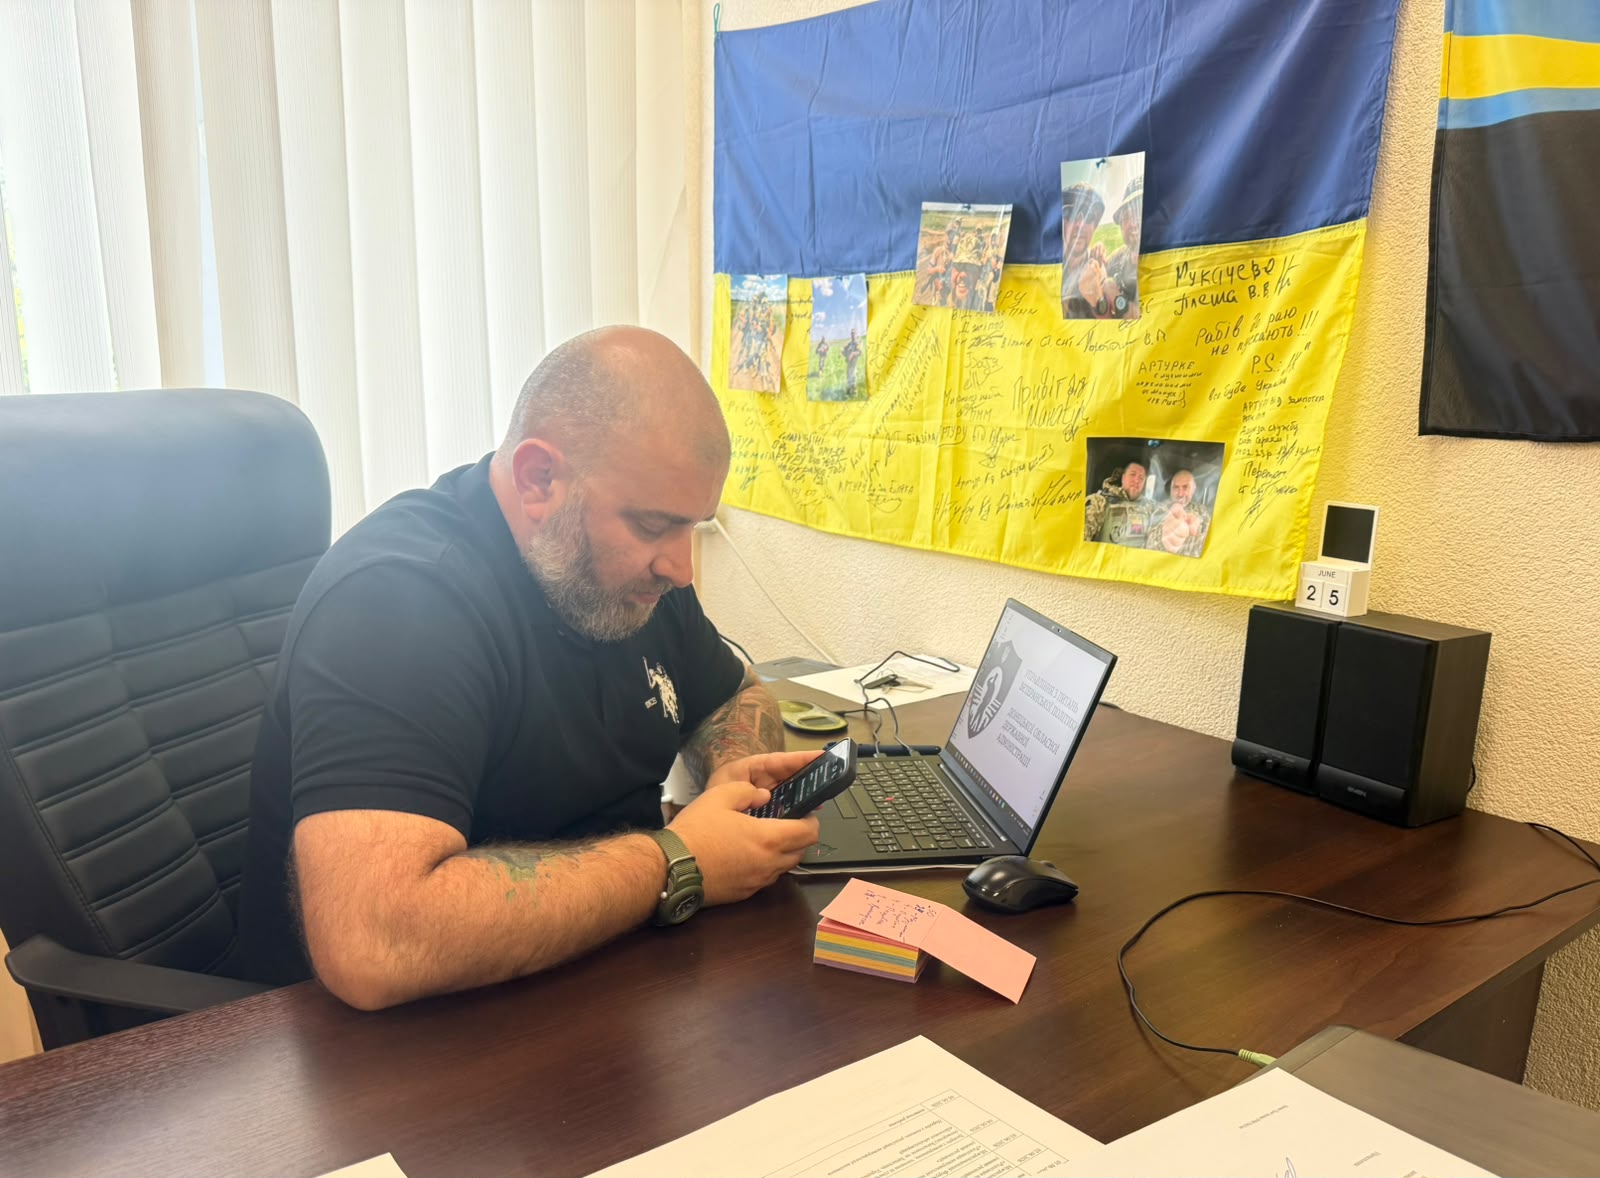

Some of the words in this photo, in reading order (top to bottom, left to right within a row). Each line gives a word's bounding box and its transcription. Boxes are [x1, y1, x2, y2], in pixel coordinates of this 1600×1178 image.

[1318, 570, 1336, 578] JUNE
[1306, 584, 1316, 601] 2
[1328, 589, 1339, 606] 5
